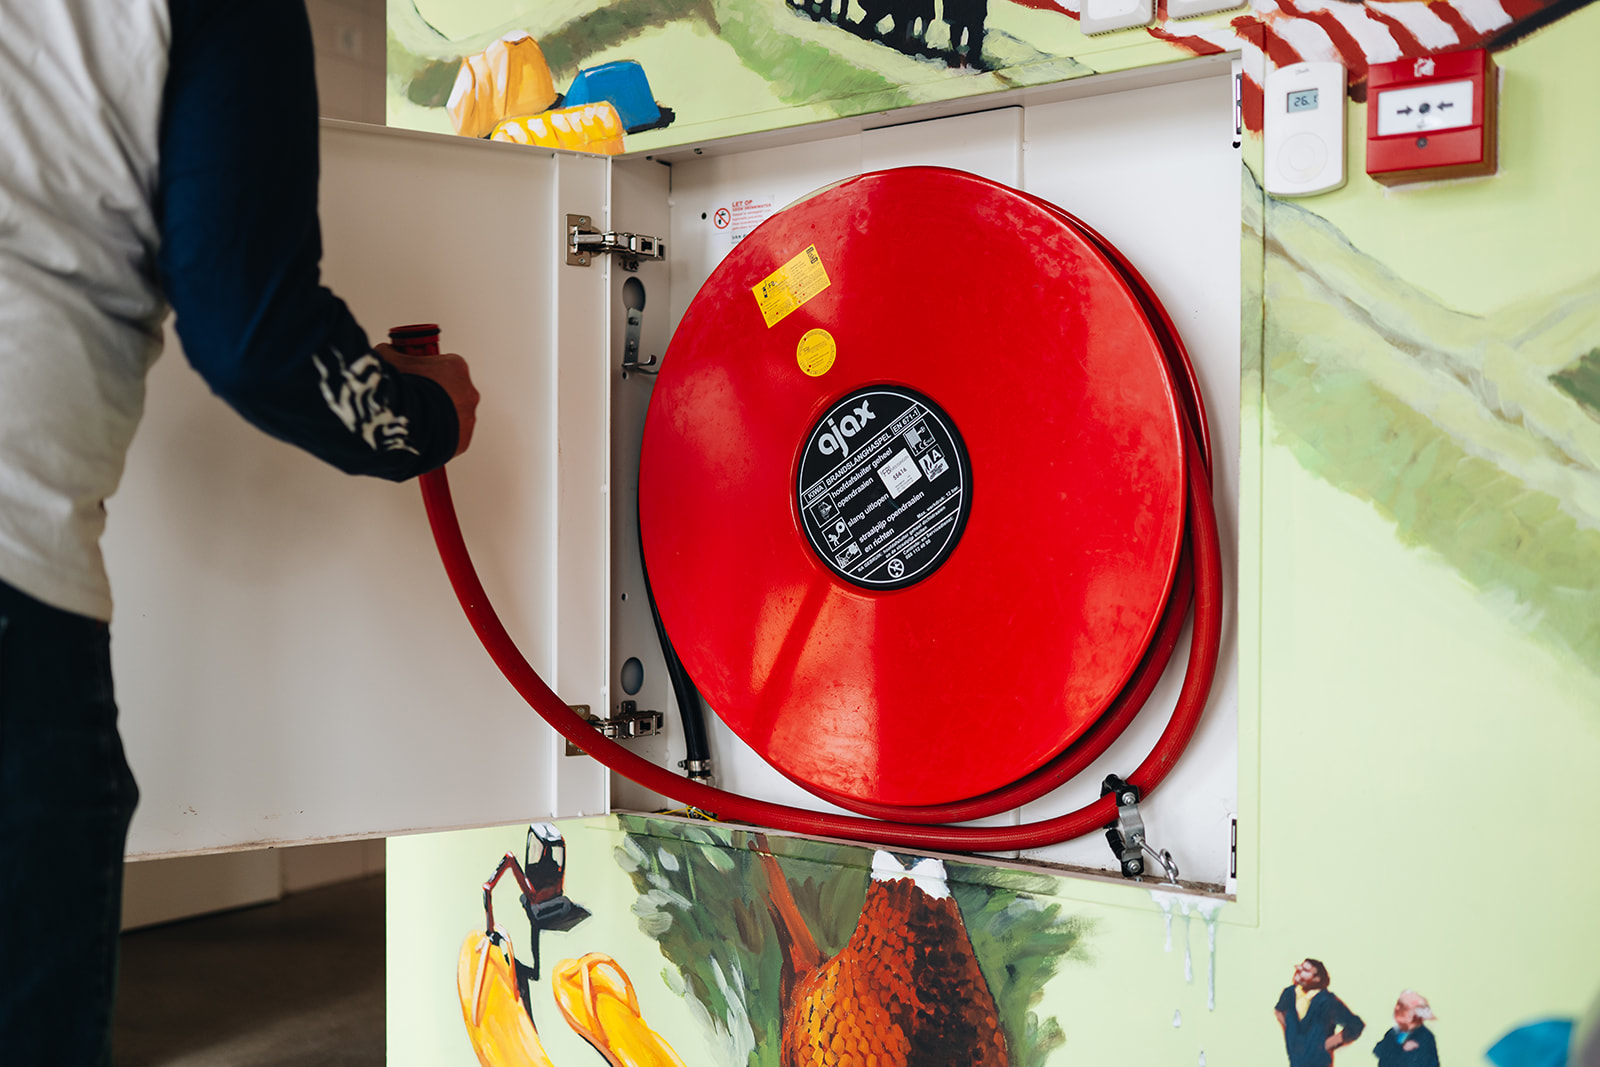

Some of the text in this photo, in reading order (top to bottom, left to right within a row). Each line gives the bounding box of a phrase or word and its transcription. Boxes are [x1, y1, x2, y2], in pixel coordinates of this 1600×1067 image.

[818, 400, 876, 458] ajax
[892, 409, 919, 433] EN 671-1
[825, 432, 892, 486] BRANDSLANGHASPEL
[831, 462, 872, 498] hoofdafsluiter
[872, 447, 893, 469] geheel
[807, 484, 824, 500] KIWA
[837, 477, 874, 508] opendraaien
[847, 493, 889, 528] slang uitlopen
[859, 491, 925, 543] straalpijp opendraaien
[864, 528, 895, 553] en richten
